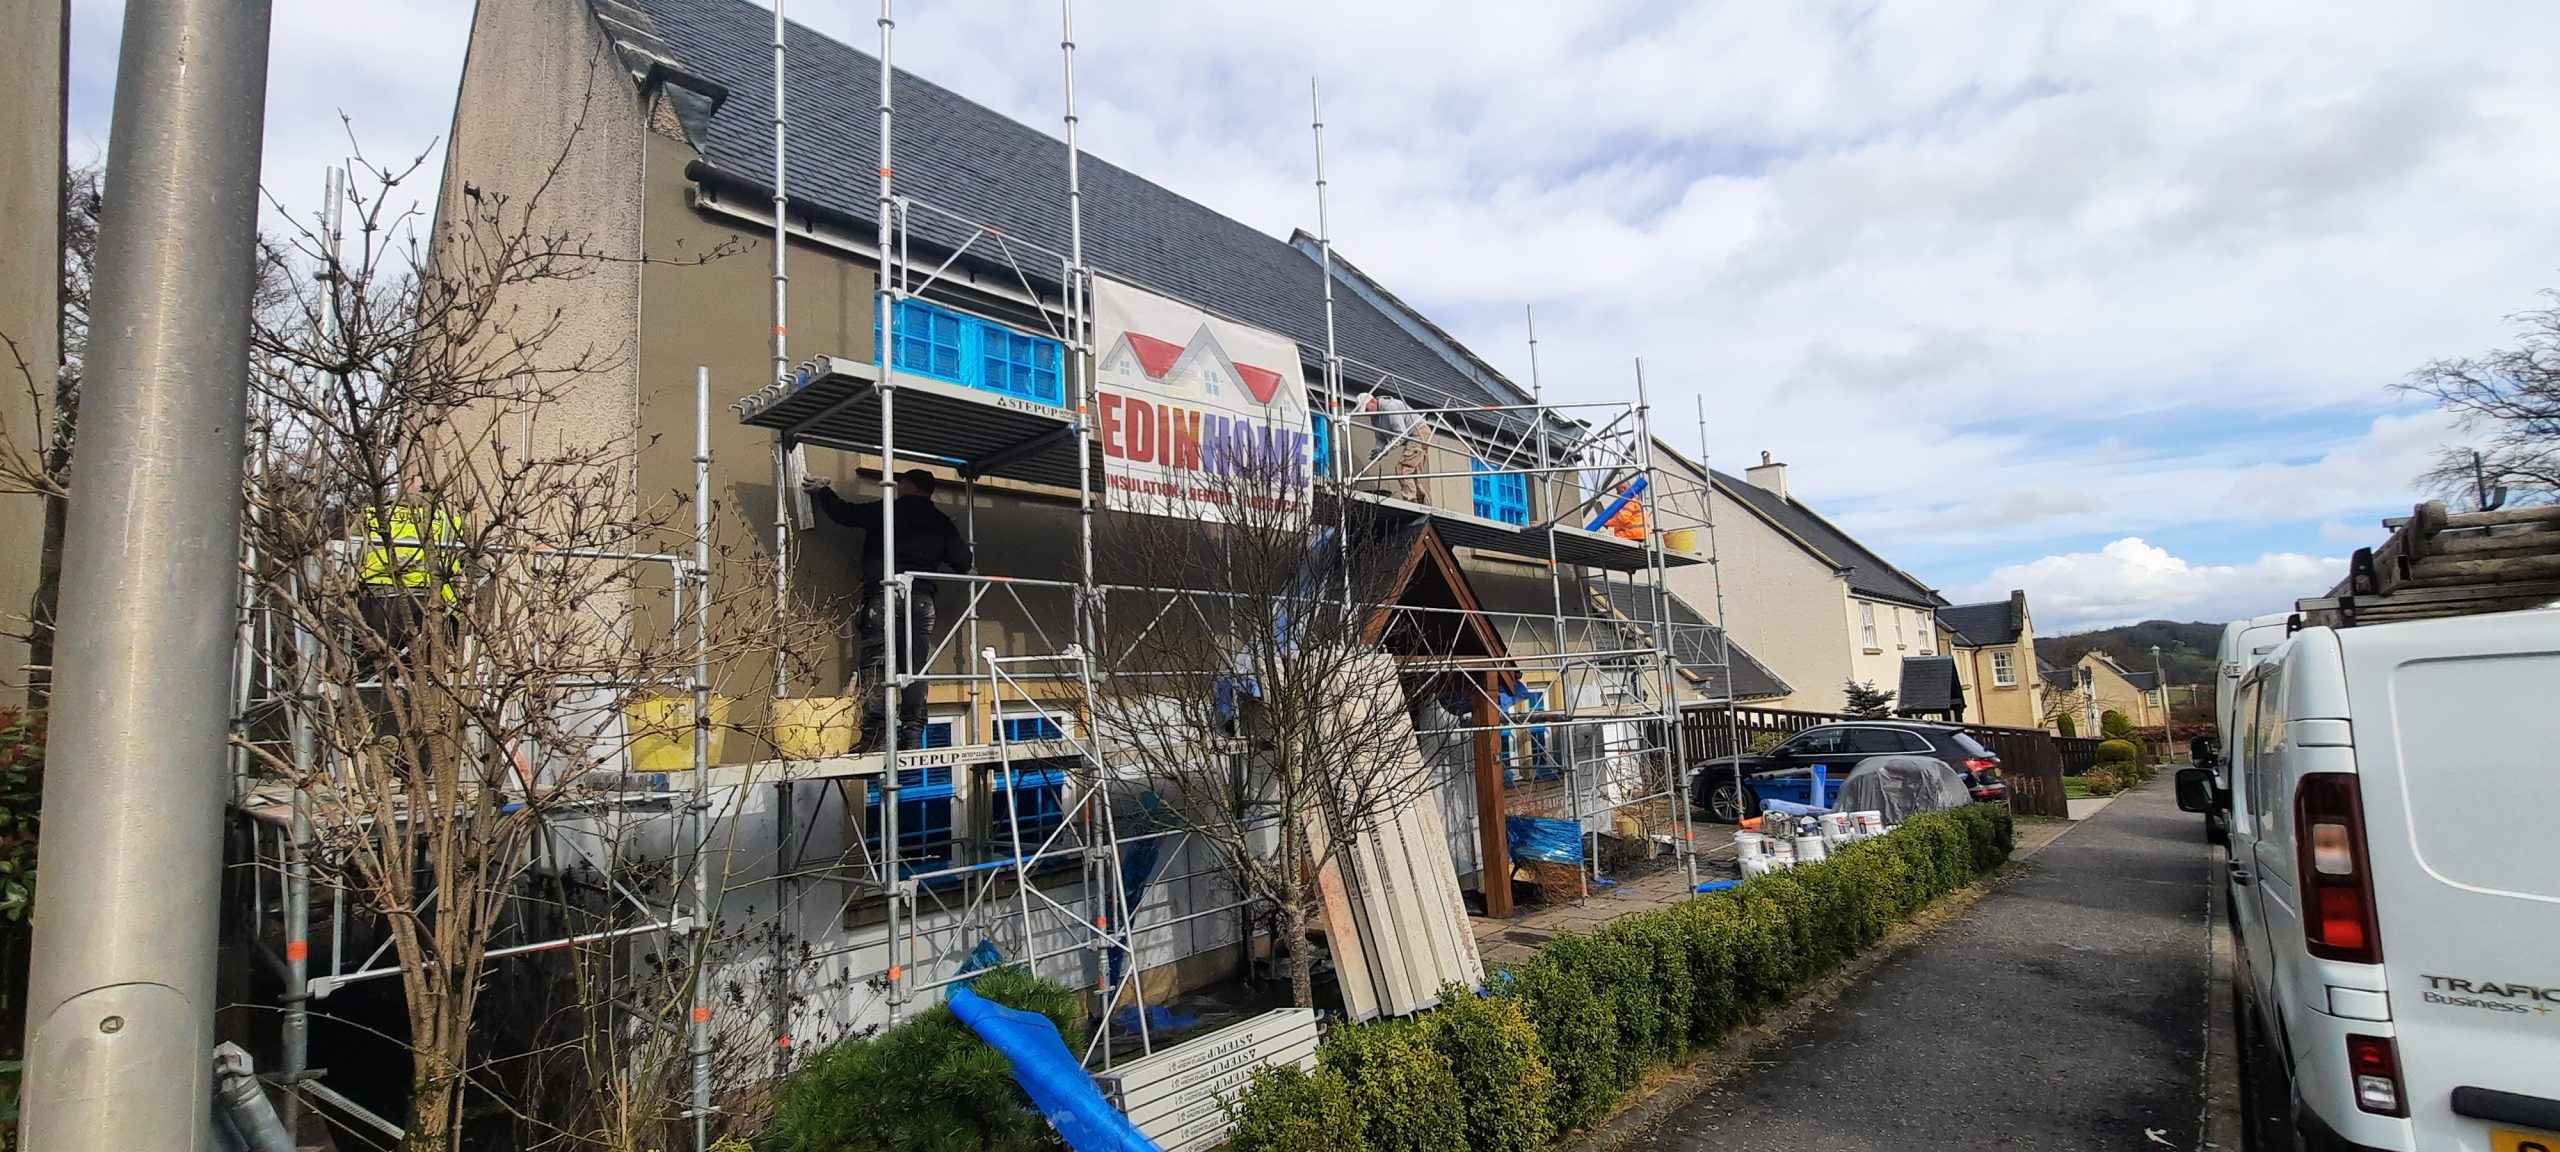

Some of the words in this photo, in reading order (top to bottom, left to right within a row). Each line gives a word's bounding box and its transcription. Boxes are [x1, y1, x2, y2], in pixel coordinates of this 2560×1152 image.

[1009, 398, 1058, 417] STEPUP
[898, 752, 960, 767] STEPUP
[2422, 991, 2530, 1014] Business
[1207, 1036, 1246, 1059] STEPUP
[1210, 1051, 1249, 1075] STEPUP
